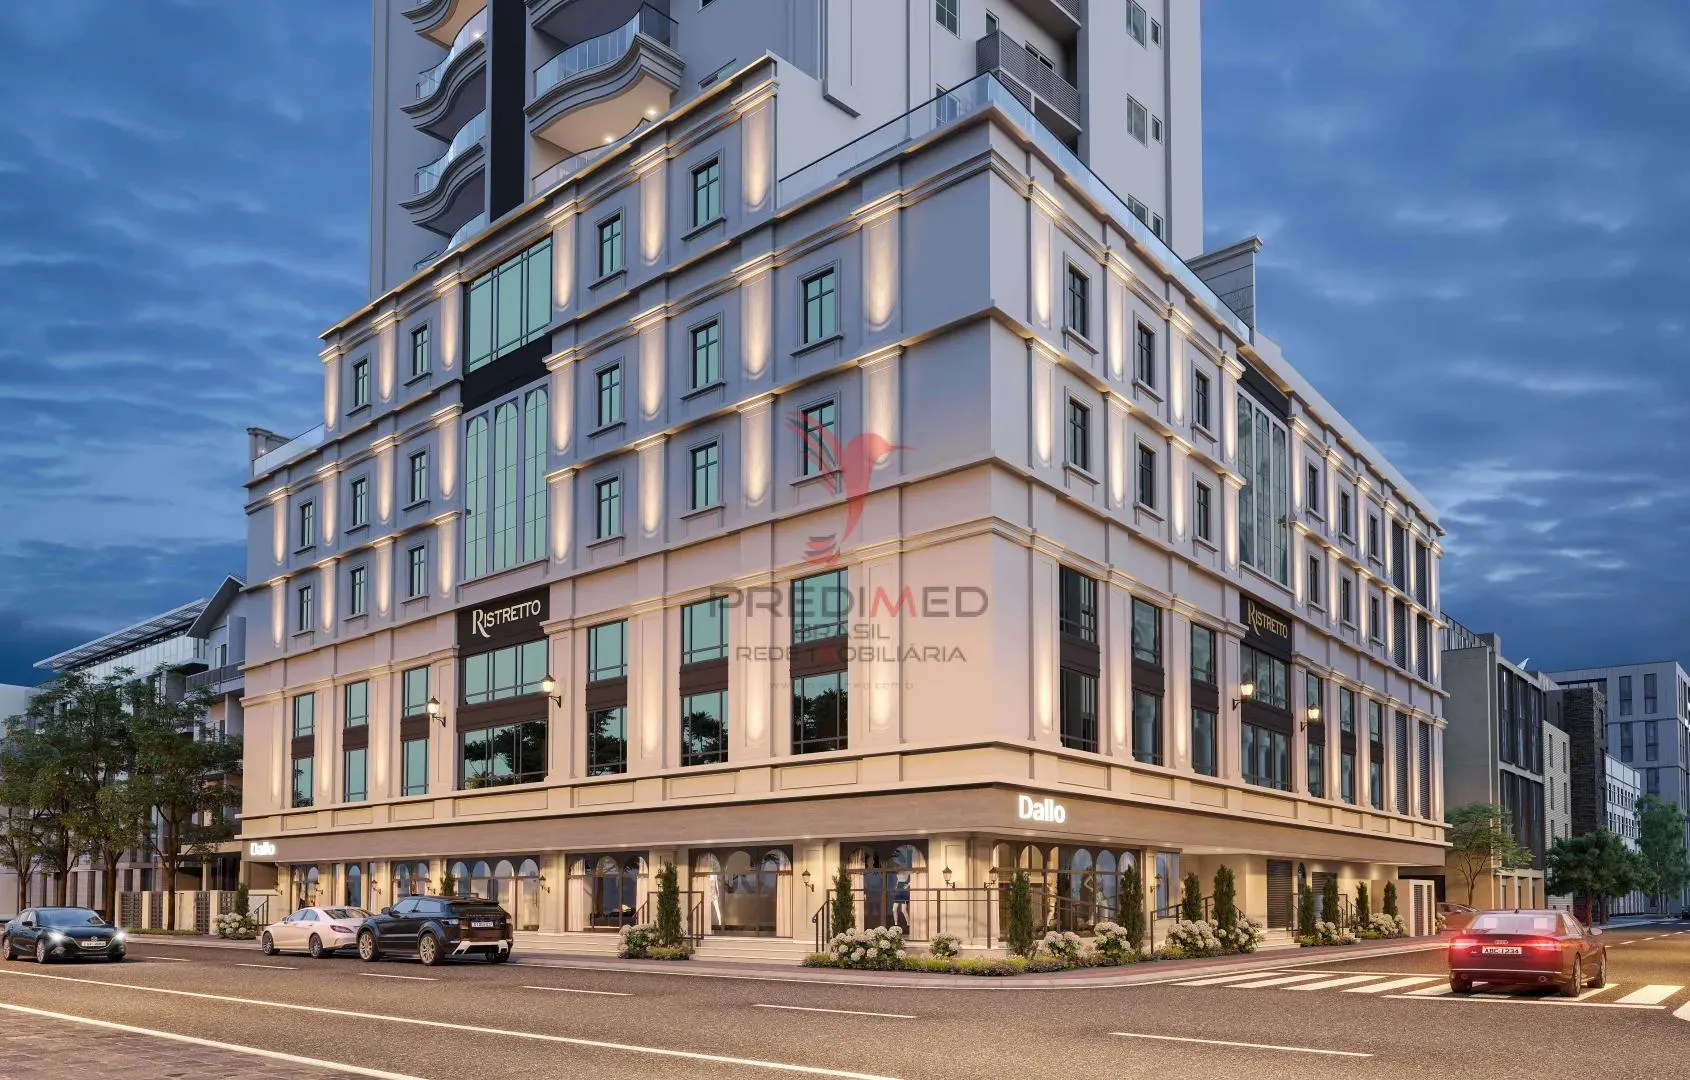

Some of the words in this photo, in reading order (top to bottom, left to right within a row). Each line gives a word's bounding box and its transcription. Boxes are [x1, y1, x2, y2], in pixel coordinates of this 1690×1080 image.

[472, 599, 541, 638] RISTRETTO
[1248, 599, 1289, 639] RISTRETTO
[1018, 794, 1066, 824] Dallo
